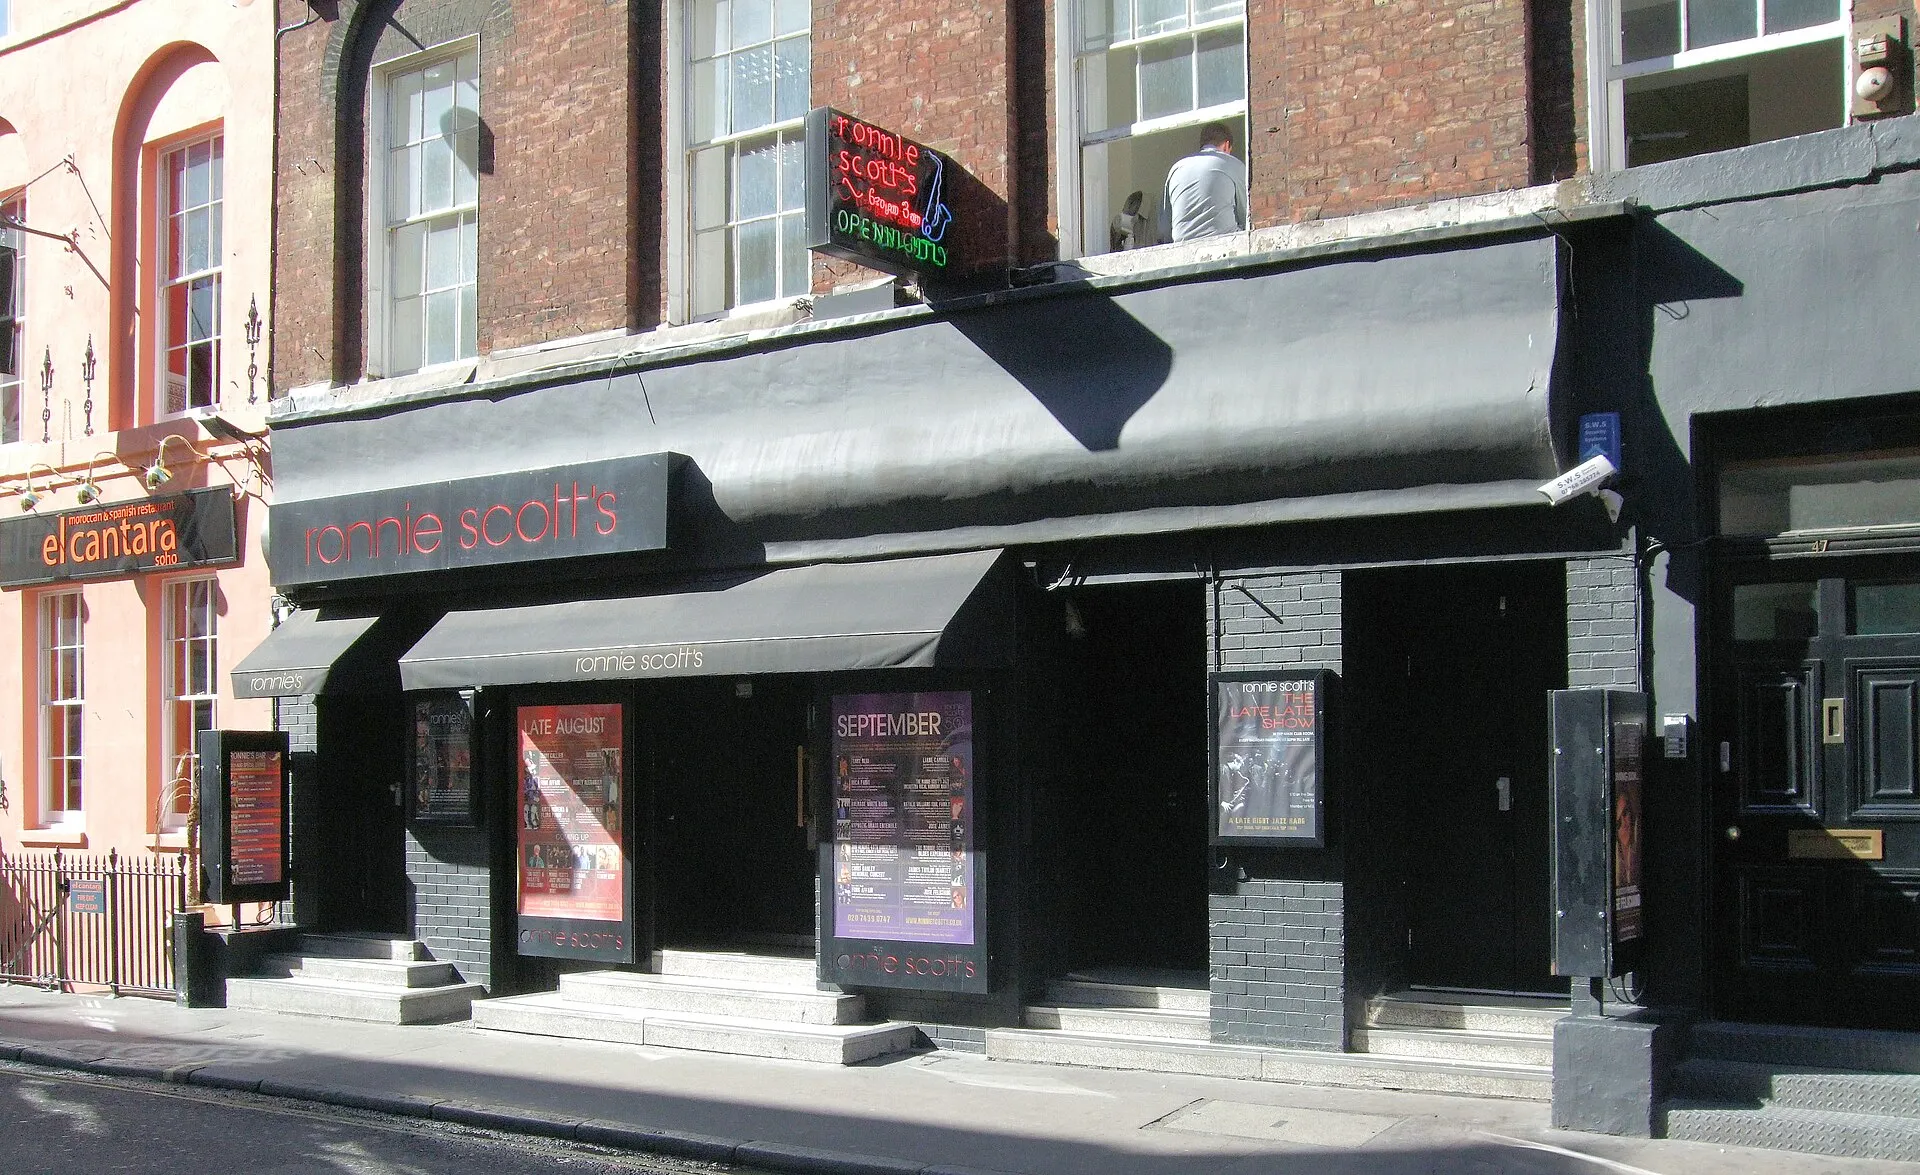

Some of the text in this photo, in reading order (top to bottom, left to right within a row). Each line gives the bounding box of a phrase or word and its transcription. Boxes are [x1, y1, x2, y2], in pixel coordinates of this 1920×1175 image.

[837, 116, 919, 165] ronnie
[68, 501, 175, 525] moroccan & spanish restaurant
[305, 480, 617, 566] ronnie scott's
[42, 515, 177, 566] el cantara
[1811, 539, 1829, 552] 47
[154, 551, 178, 566] soho
[575, 647, 703, 673] ronnie scott's
[250, 672, 303, 691] ronnie's
[1242, 680, 1314, 693] ronnie scott's
[1282, 693, 1314, 703] THE
[1231, 705, 1314, 717] LATE LATE
[524, 717, 606, 736] LATE AUGUST
[837, 712, 942, 738] SEPTEMBER
[1262, 717, 1314, 728] SHOW
